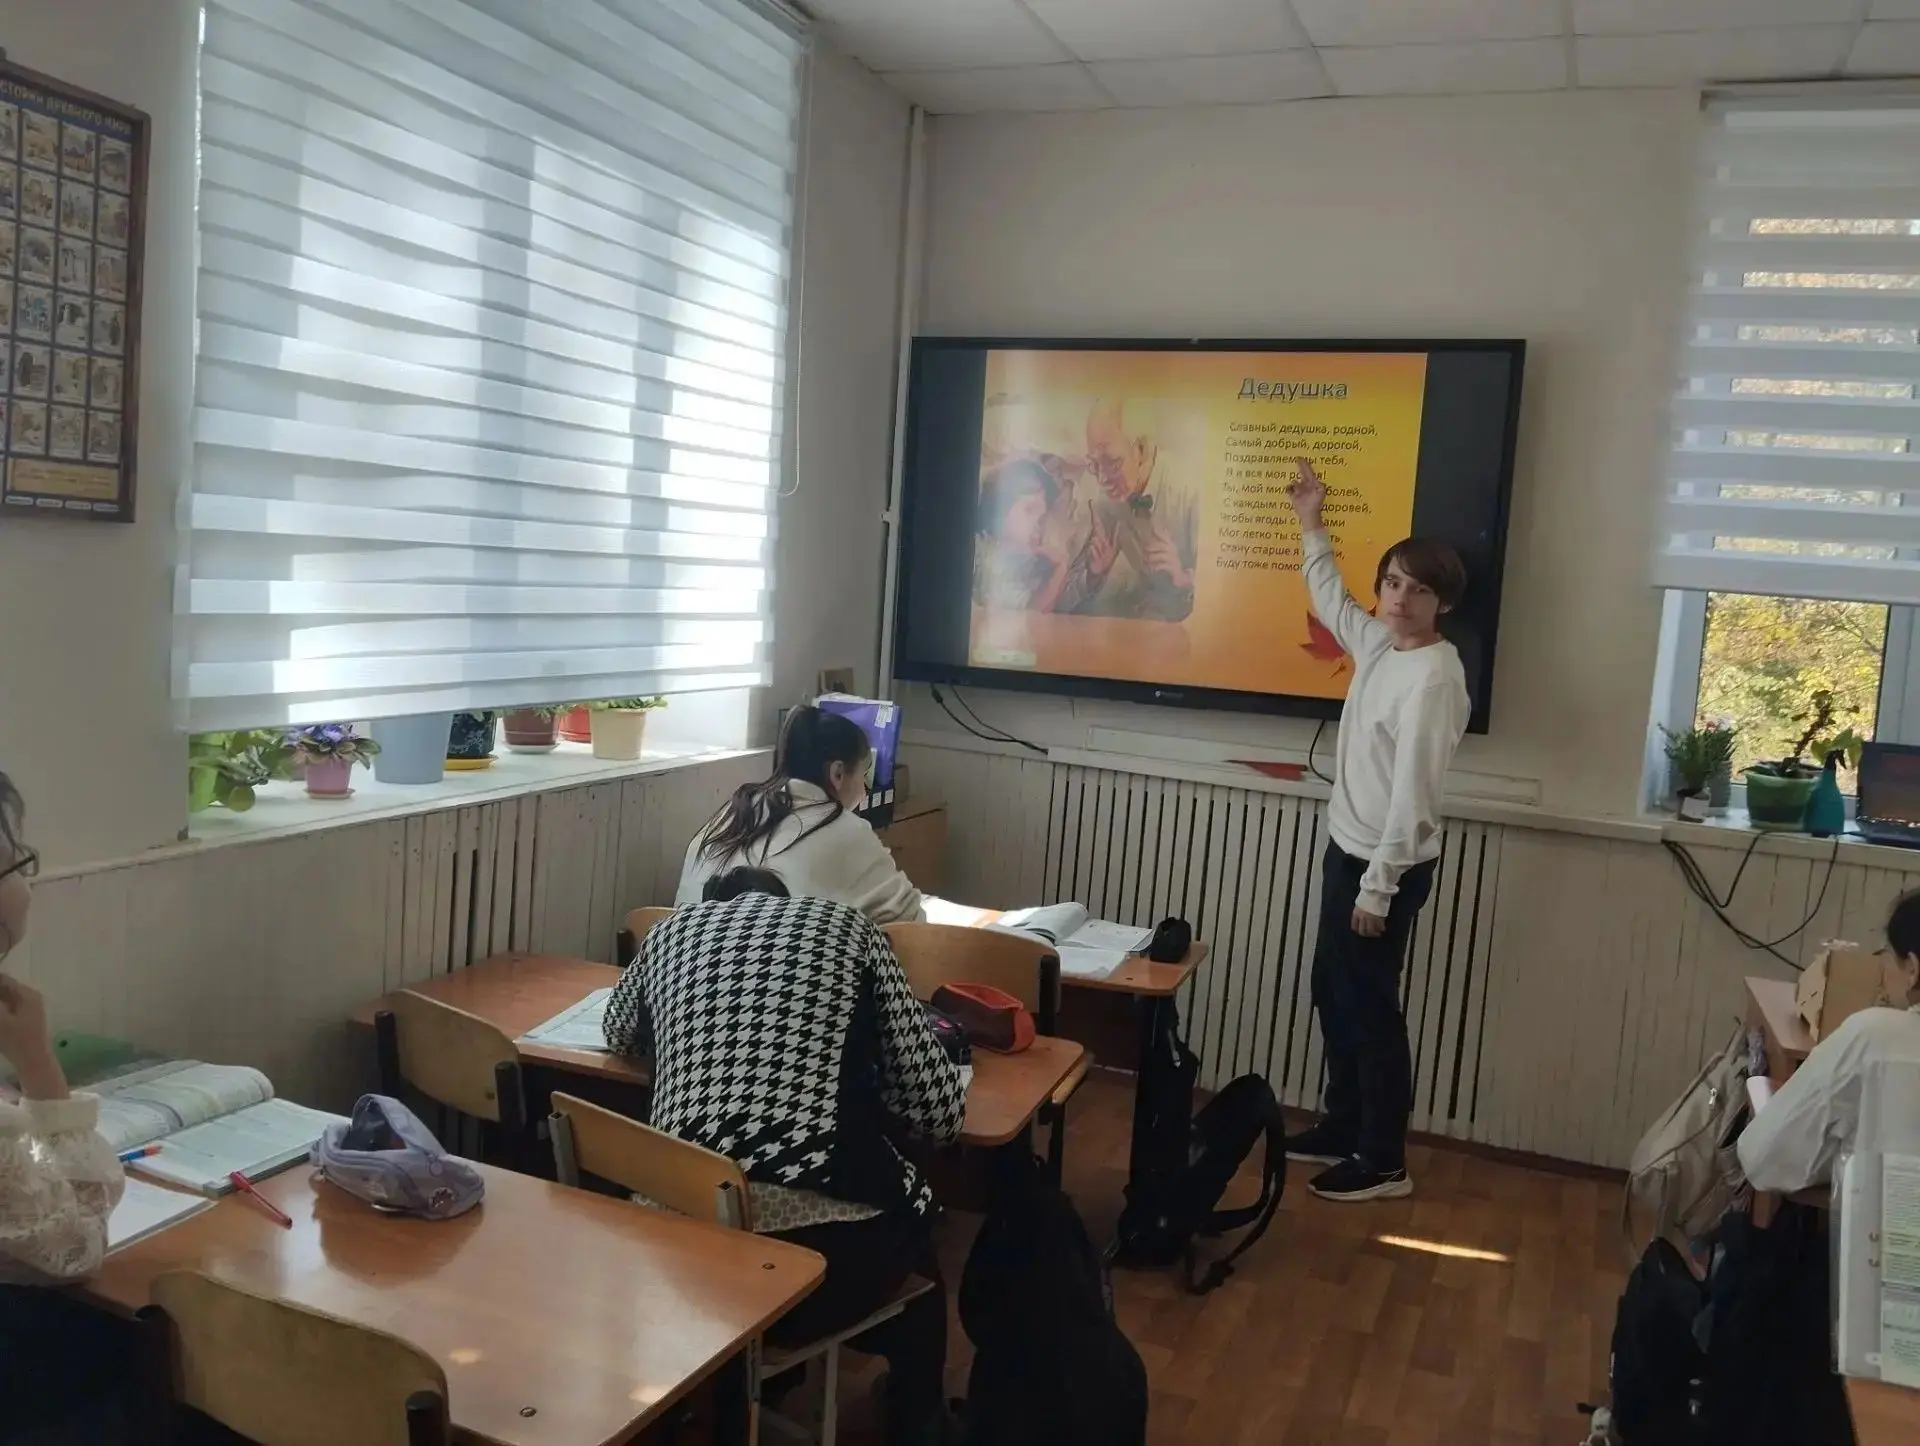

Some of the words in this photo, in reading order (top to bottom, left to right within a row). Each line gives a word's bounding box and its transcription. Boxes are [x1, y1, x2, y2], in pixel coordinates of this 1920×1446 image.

[1237, 377, 1348, 401] Дедушка
[1229, 421, 1276, 434] Славный
[1278, 424, 1330, 436] дедушка,
[1332, 423, 1378, 436] родной,
[1226, 437, 1262, 448] Самый
[1264, 438, 1310, 450] добрый,
[1312, 439, 1363, 452] дорогой,
[1224, 452, 1298, 464] Поздравляем
[1319, 454, 1348, 466] тебя,
[1226, 468, 1234, 476] Я
[1245, 470, 1262, 478] вся
[1265, 470, 1287, 479] моя
[1242, 484, 1262, 493] мой
[1224, 500, 1230, 508] С
[1232, 501, 1277, 510] каждым
[1220, 512, 1252, 524] Чтобы
[1254, 514, 1288, 526] ягоды
[1218, 527, 1240, 538] Мог
[1242, 530, 1272, 540] легко
[1275, 531, 1288, 540] ты
[1220, 542, 1250, 554] Стану
[1252, 546, 1291, 558] старше
[1292, 548, 1300, 556] я
[1216, 556, 1240, 569] Буду
[1242, 559, 1268, 570] тоже
